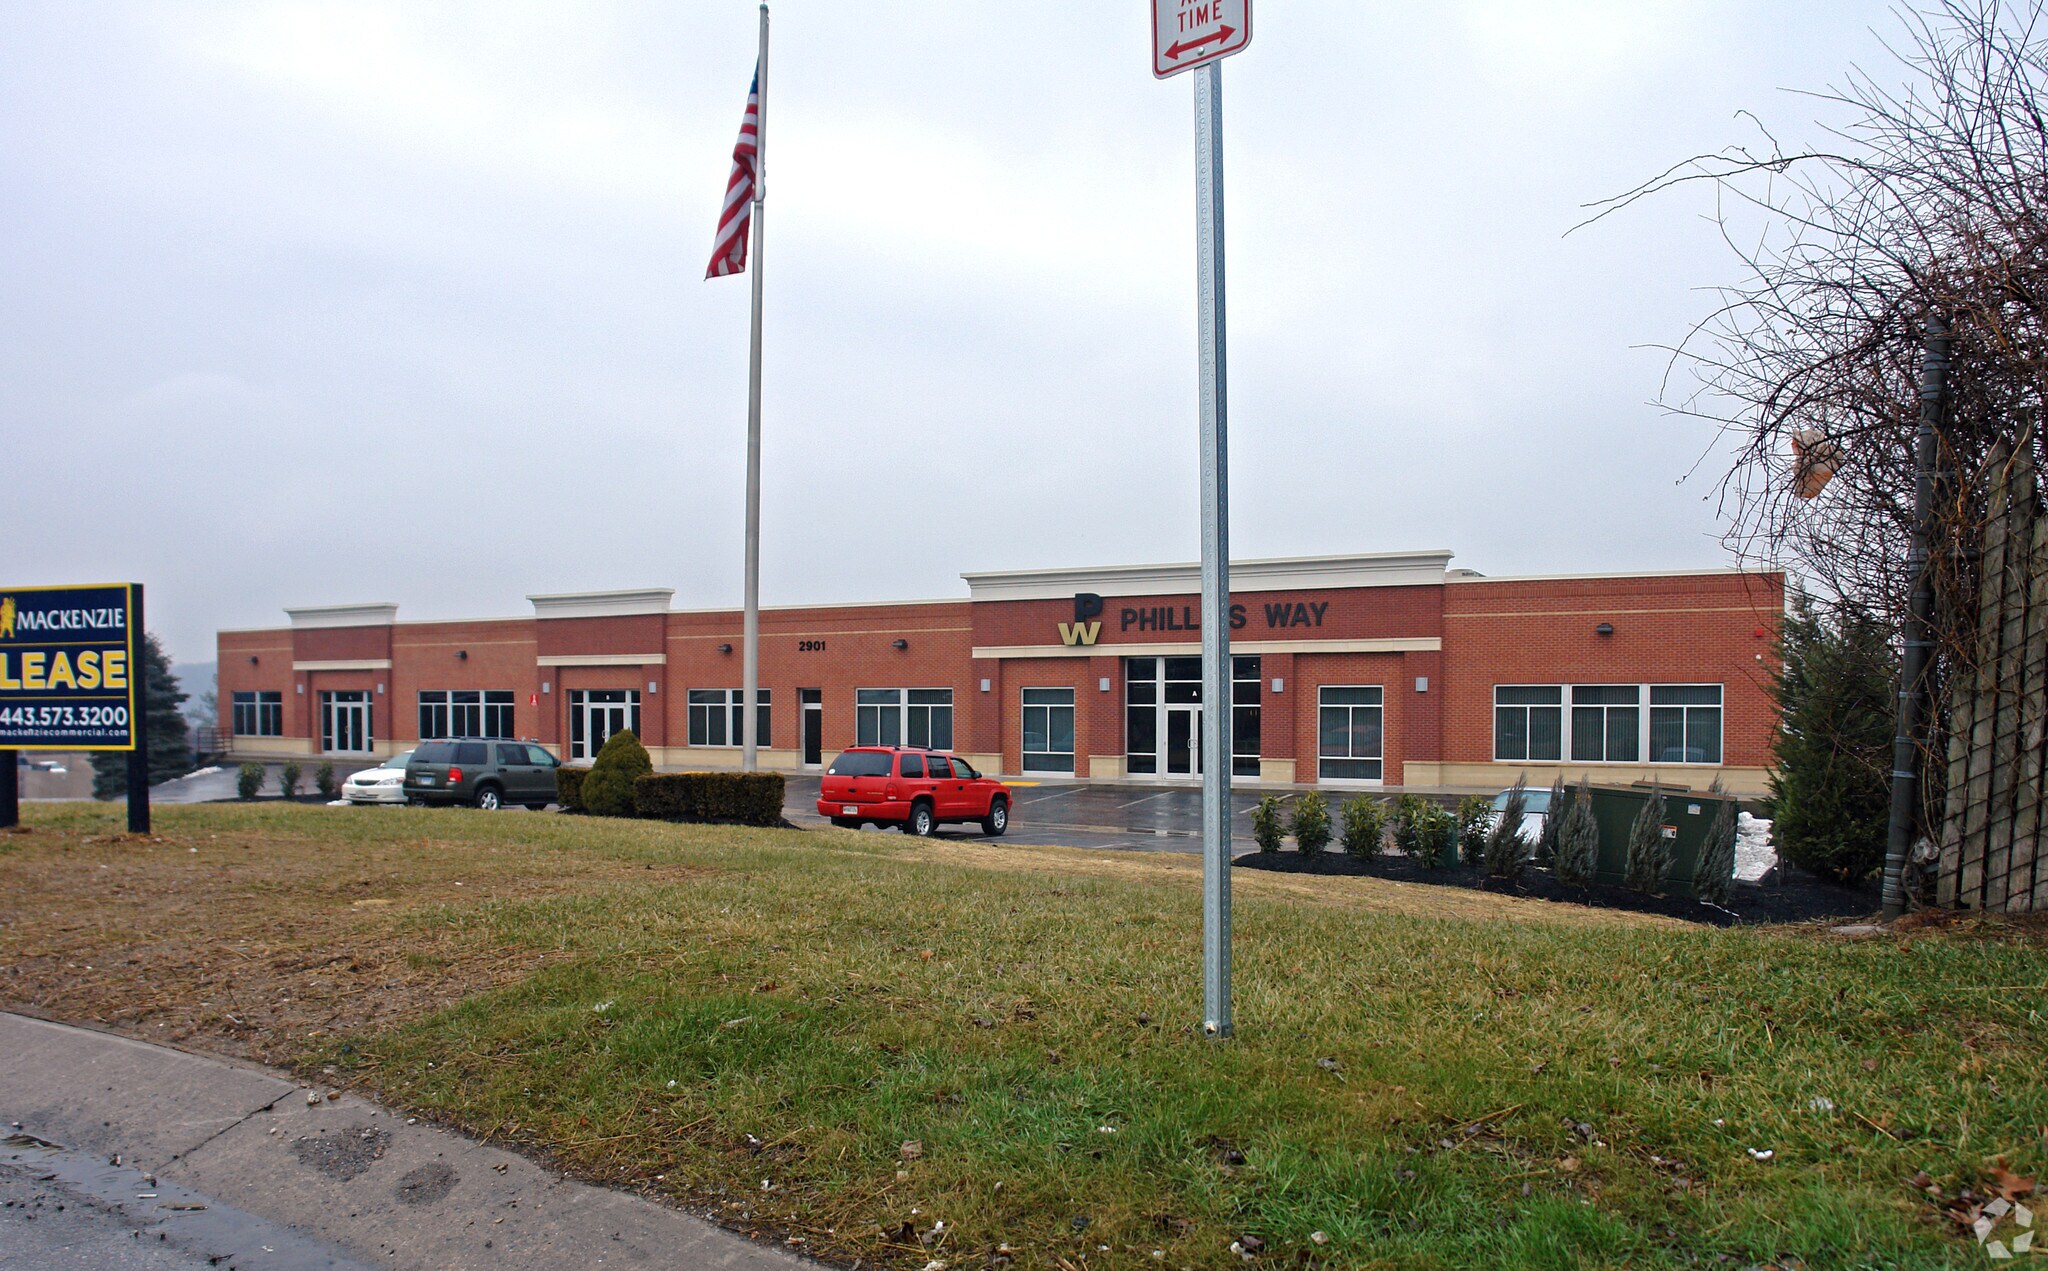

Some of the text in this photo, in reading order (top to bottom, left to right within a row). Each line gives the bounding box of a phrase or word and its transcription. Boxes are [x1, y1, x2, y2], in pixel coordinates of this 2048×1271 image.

[1177, 0, 1222, 32] TIME
[17, 608, 125, 630] MACKENZIE
[1121, 602, 1329, 631] PHILLS WAY
[799, 640, 826, 651] 2901
[0, 650, 127, 690] LEASE
[0, 706, 128, 726] 443.573.3200
